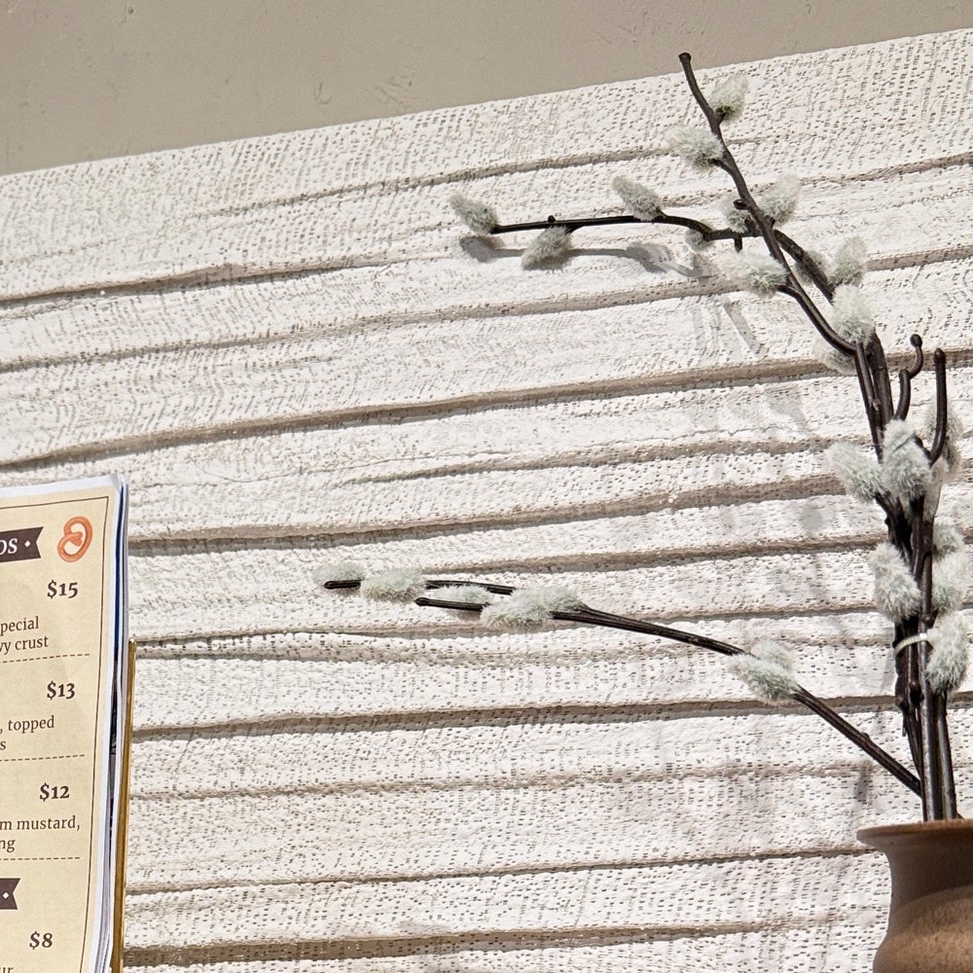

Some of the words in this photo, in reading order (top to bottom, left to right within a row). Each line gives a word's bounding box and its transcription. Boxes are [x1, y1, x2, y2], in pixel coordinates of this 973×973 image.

[47, 580, 78, 598] $15
[15, 635, 49, 650] crust
[47, 681, 75, 700] $13
[8, 716, 55, 733] topped
[39, 783, 69, 801] $12
[16, 816, 81, 830] mustard,
[29, 931, 53, 950] $8
